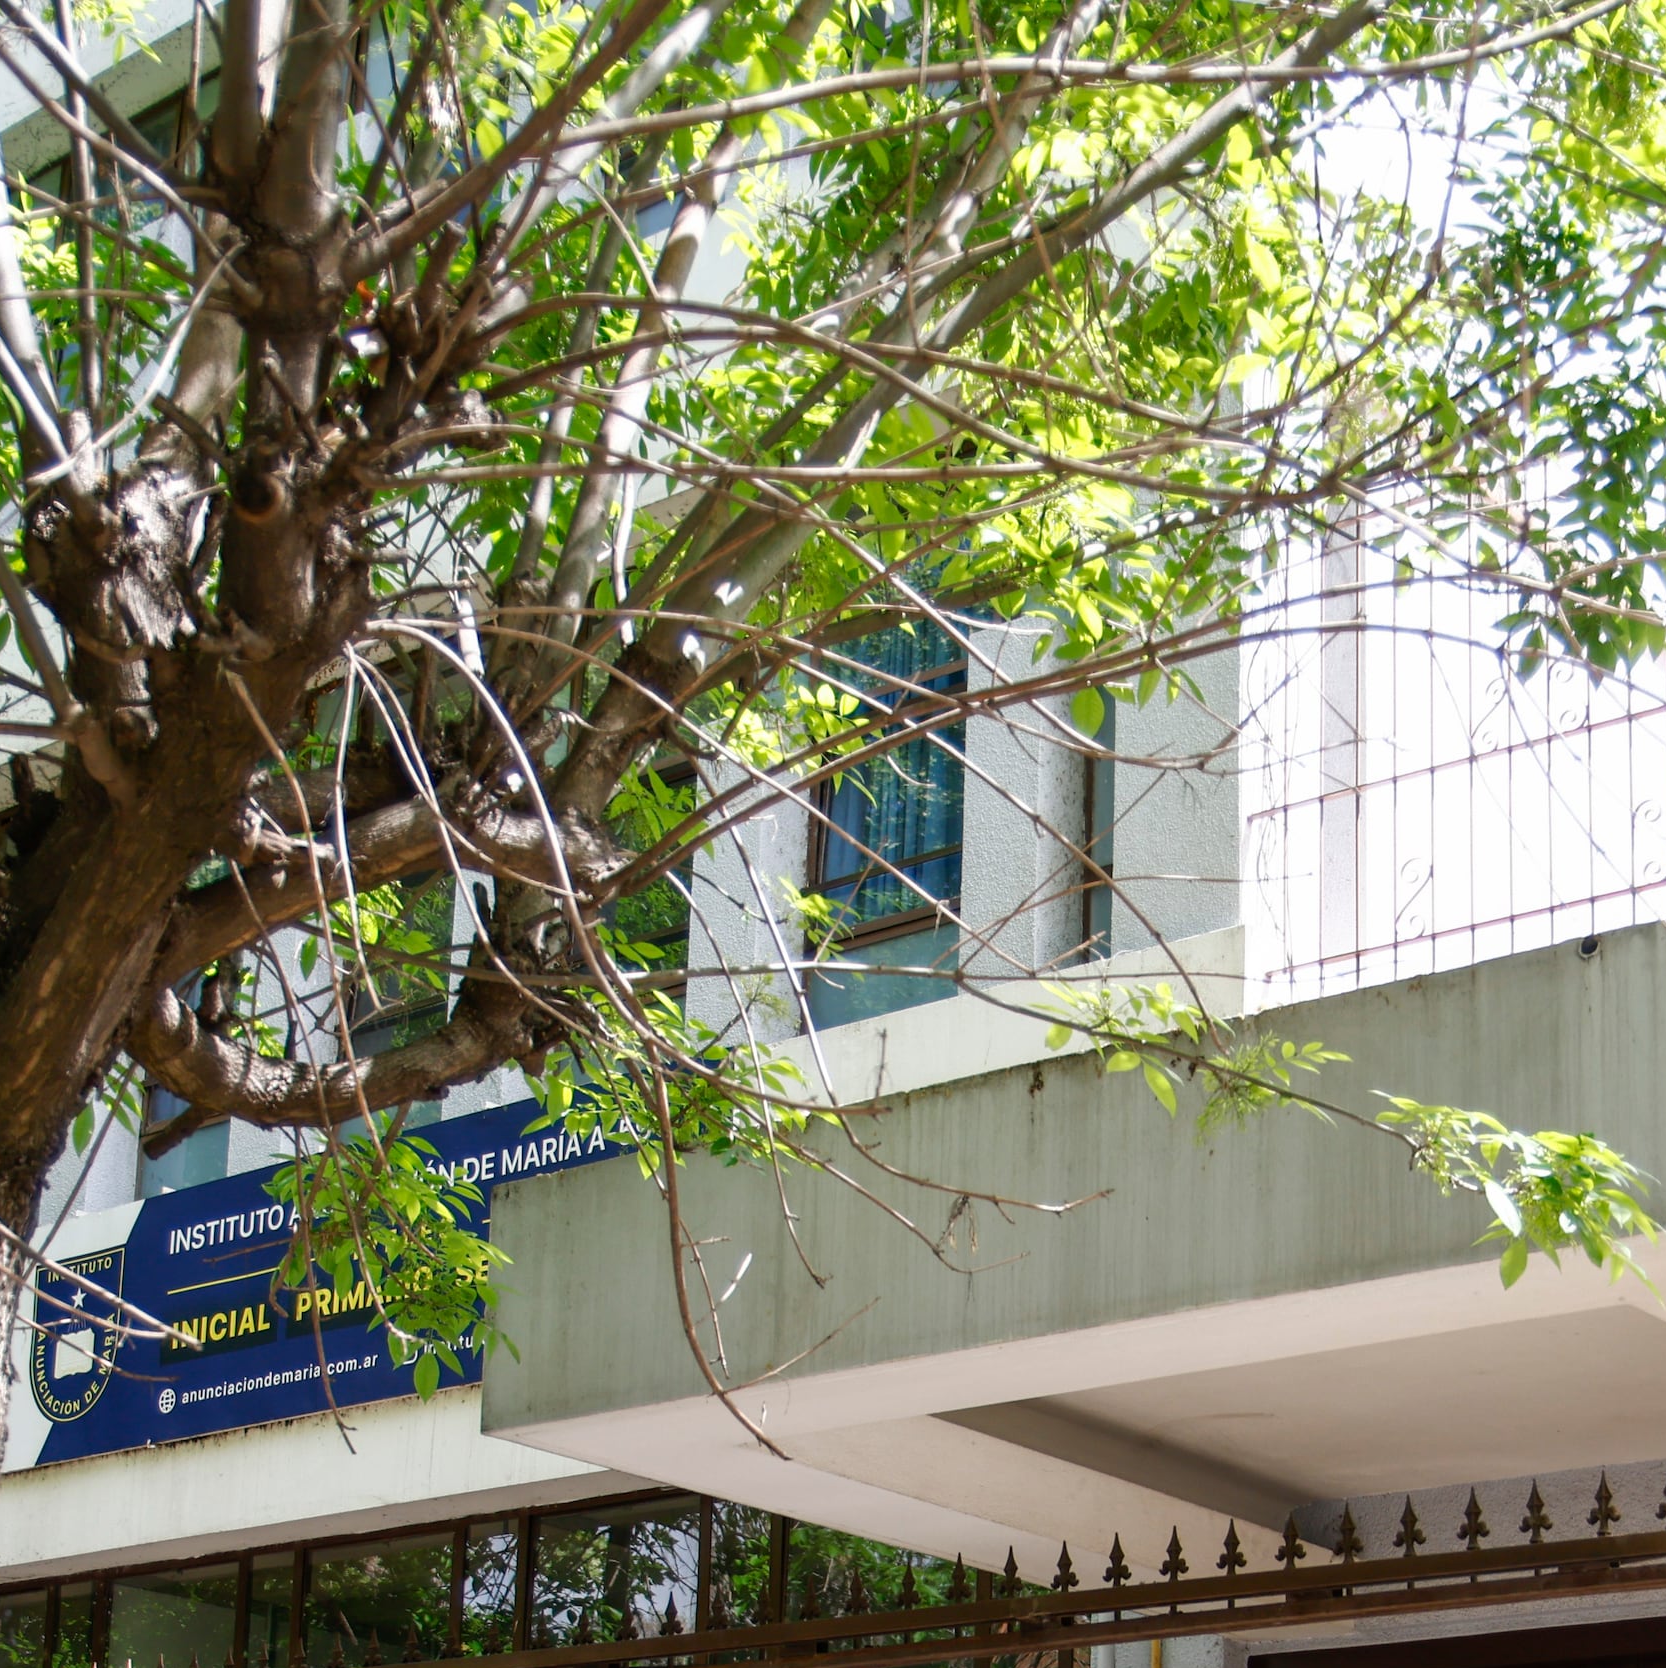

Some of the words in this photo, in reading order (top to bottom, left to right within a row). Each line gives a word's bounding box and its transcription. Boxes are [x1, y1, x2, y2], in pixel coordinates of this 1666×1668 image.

[169, 1204, 284, 1255] INSTITUTO
[463, 1152, 496, 1184] DE
[501, 1128, 582, 1176] MARÍA
[47, 1256, 113, 1283] INTITUTO
[171, 1303, 271, 1350] INICIAL
[295, 1266, 434, 1322] PRIMAO
[36, 1332, 81, 1416] ANUNCIACIÓN
[84, 1380, 100, 1404] DE
[181, 1354, 379, 1405] anunciaciondemariacom.ar
